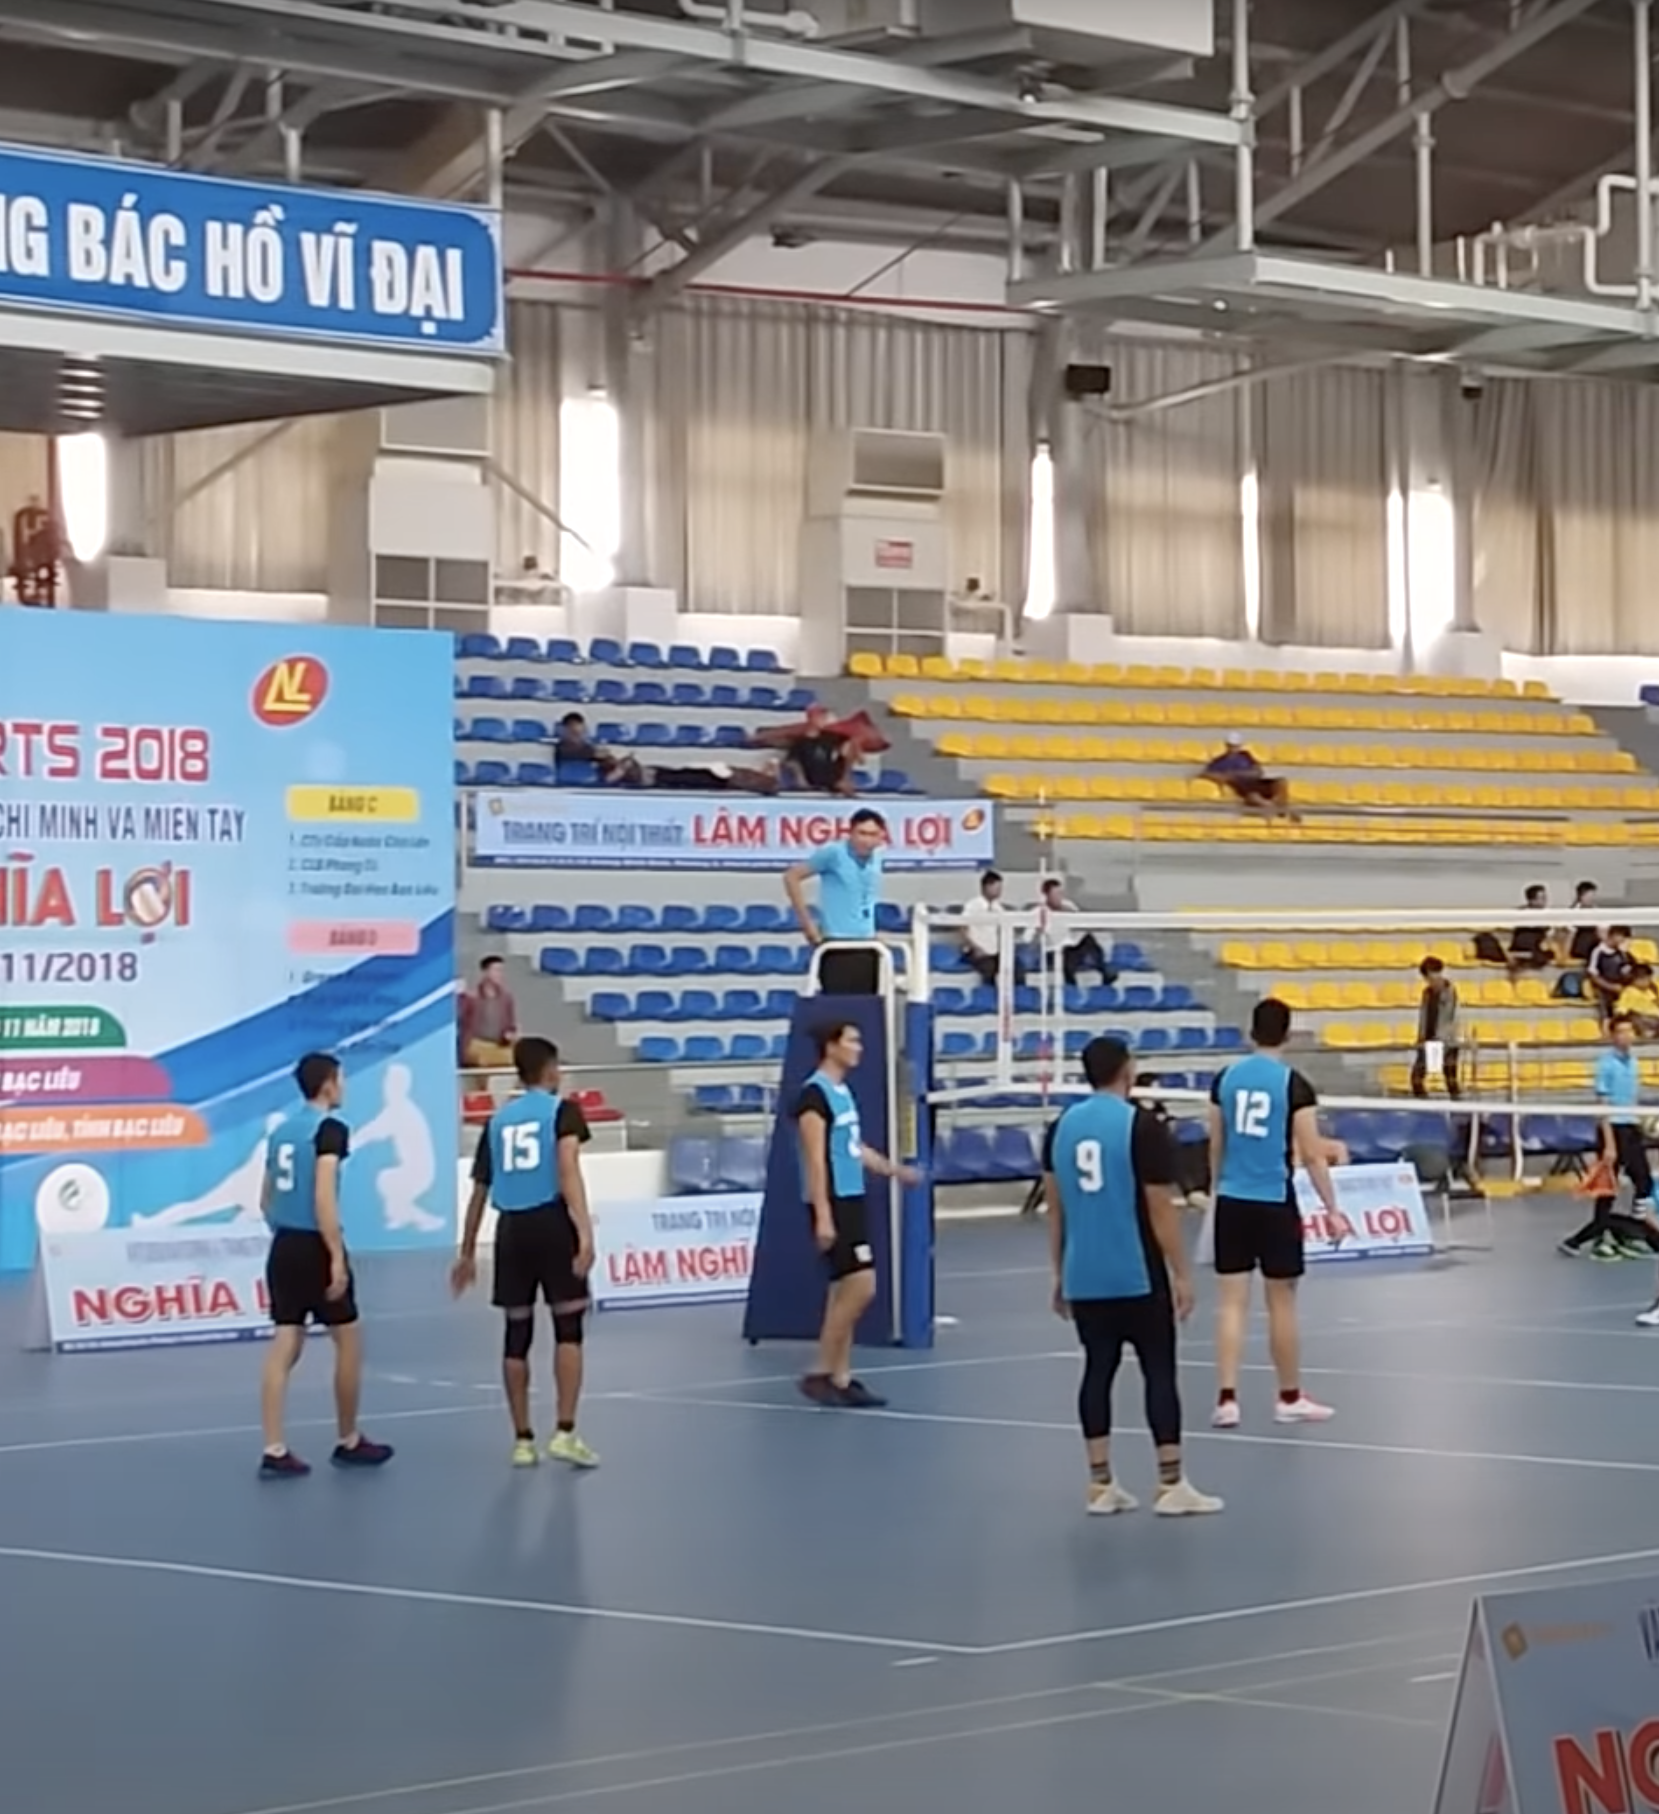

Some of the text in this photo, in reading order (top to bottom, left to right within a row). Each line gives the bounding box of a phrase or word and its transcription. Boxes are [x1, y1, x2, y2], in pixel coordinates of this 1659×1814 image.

[67, 192, 187, 293] BÁC
[205, 204, 285, 303] HỒ
[300, 222, 359, 311] VĨ
[370, 239, 465, 334] ĐẠI
[99, 727, 209, 782] 2018
[40, 804, 98, 840] MINH
[502, 819, 567, 846] TRANG
[693, 806, 767, 845] LÂM
[904, 812, 952, 855] LỢI
[0, 851, 191, 945] ĨA LỢI
[1, 951, 138, 982] 11/2018
[2, 1072, 41, 1097] BẠC
[1235, 1090, 1271, 1138] 12
[501, 1121, 541, 1172] 15
[1075, 1140, 1103, 1192] 9
[1364, 1205, 1413, 1243] LỢI
[73, 1275, 241, 1323] NGHĨA
